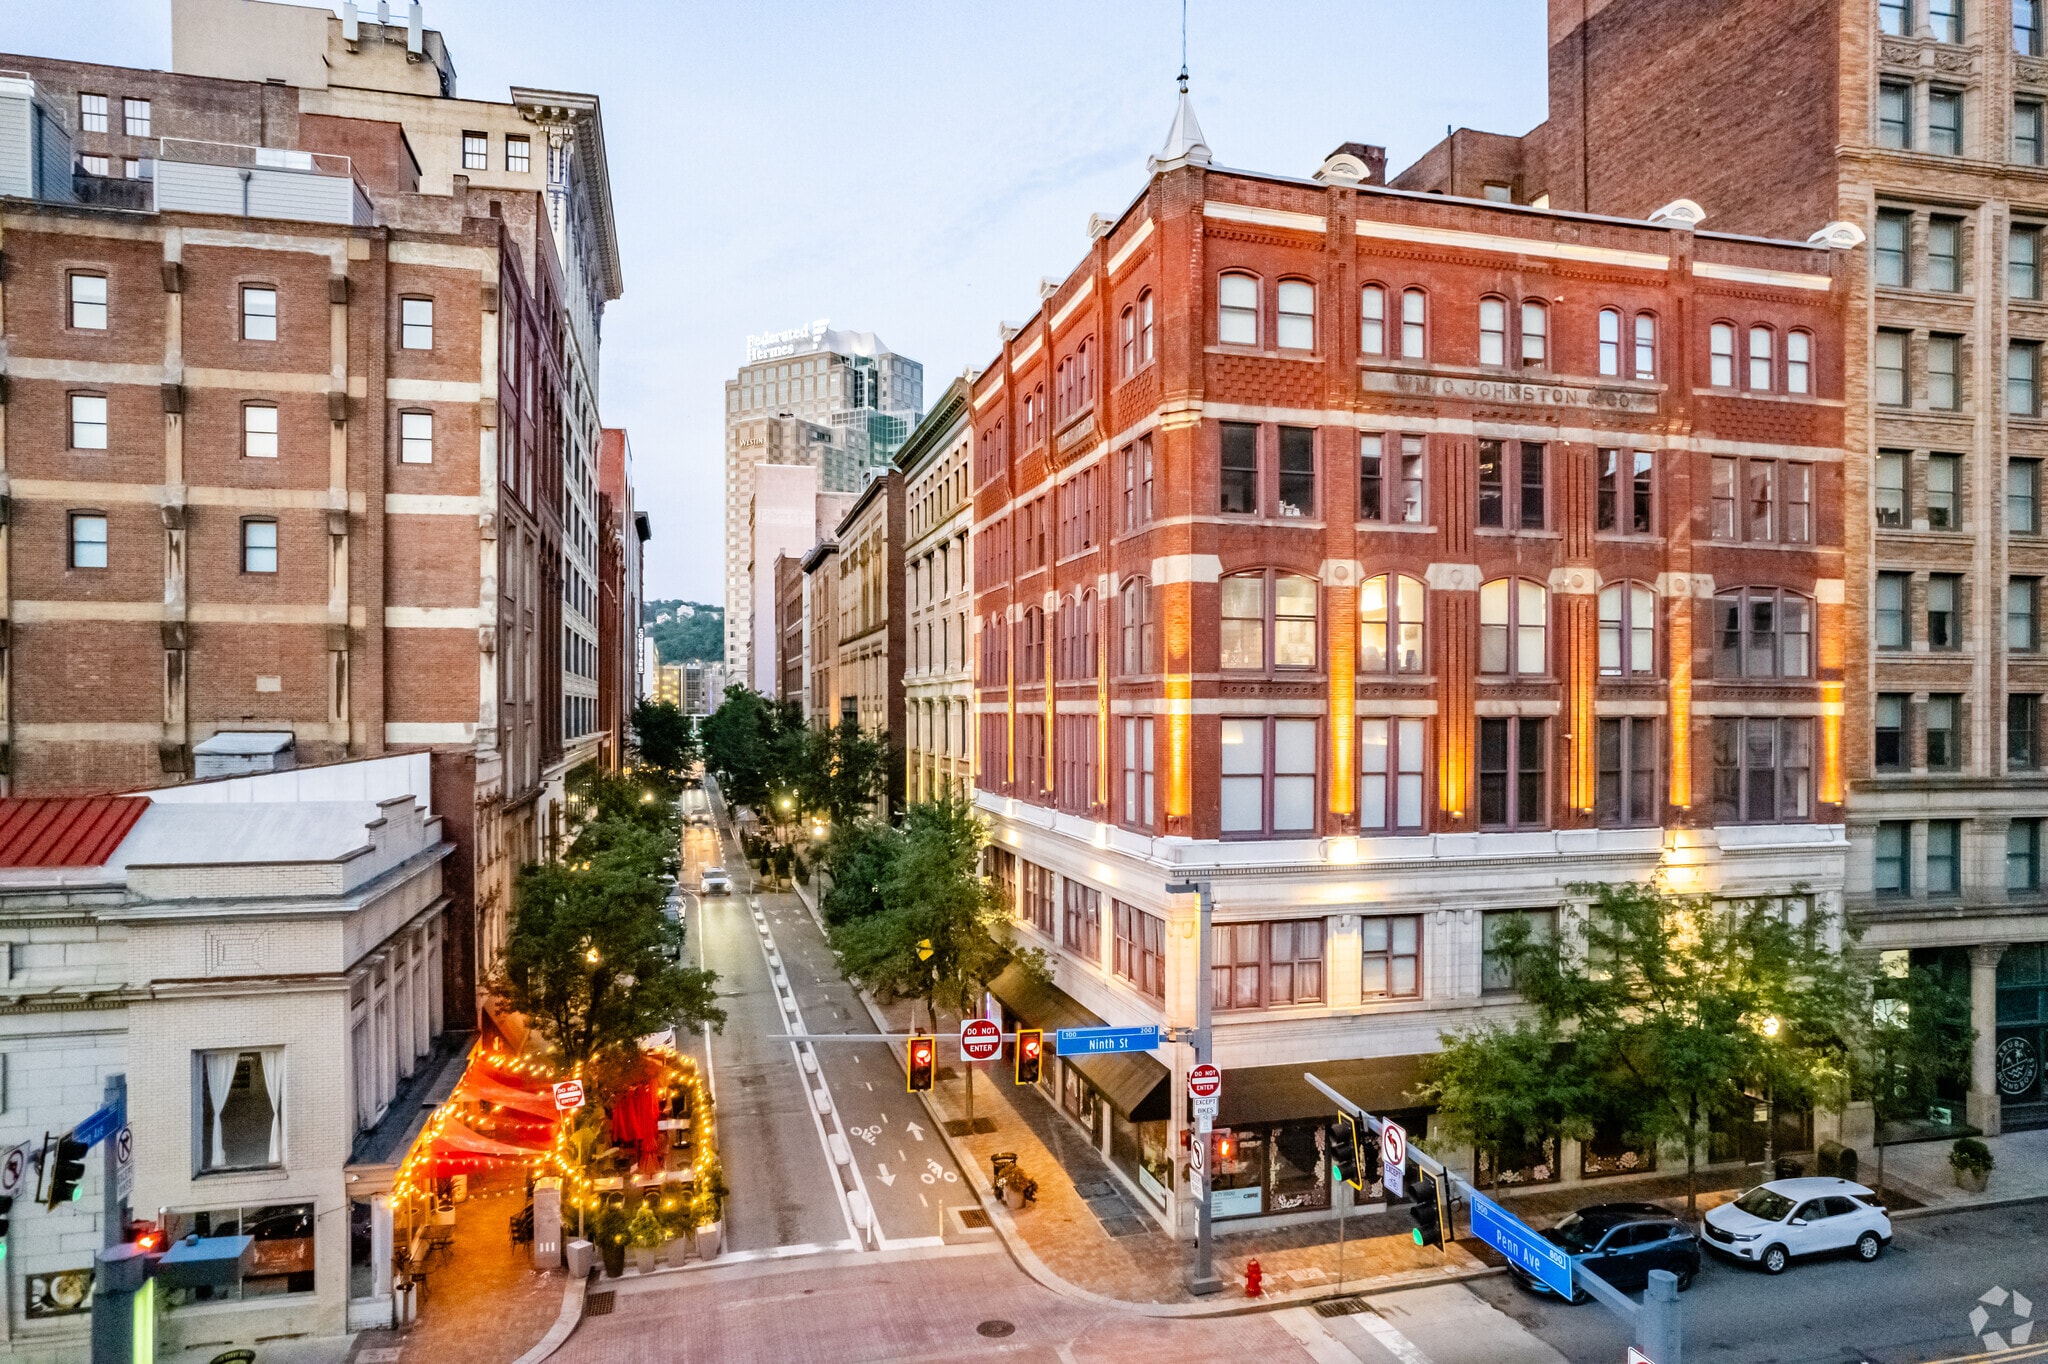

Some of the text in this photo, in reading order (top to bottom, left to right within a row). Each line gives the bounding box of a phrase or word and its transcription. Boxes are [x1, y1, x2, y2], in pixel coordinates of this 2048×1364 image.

[746, 323, 809, 347] Federated
[747, 343, 795, 361] Hermes
[1465, 381, 1578, 404] JOHNSTON
[1587, 391, 1600, 405] &
[740, 438, 765, 447] WESTIN
[967, 1027, 995, 1036] DO NOT
[970, 1044, 993, 1052] ENTER
[1089, 1038, 1129, 1050] Ninth St
[1998, 1040, 2025, 1058] ARUBA
[1496, 1229, 1540, 1272] Penn Ave
[1549, 1249, 1563, 1265] 800
